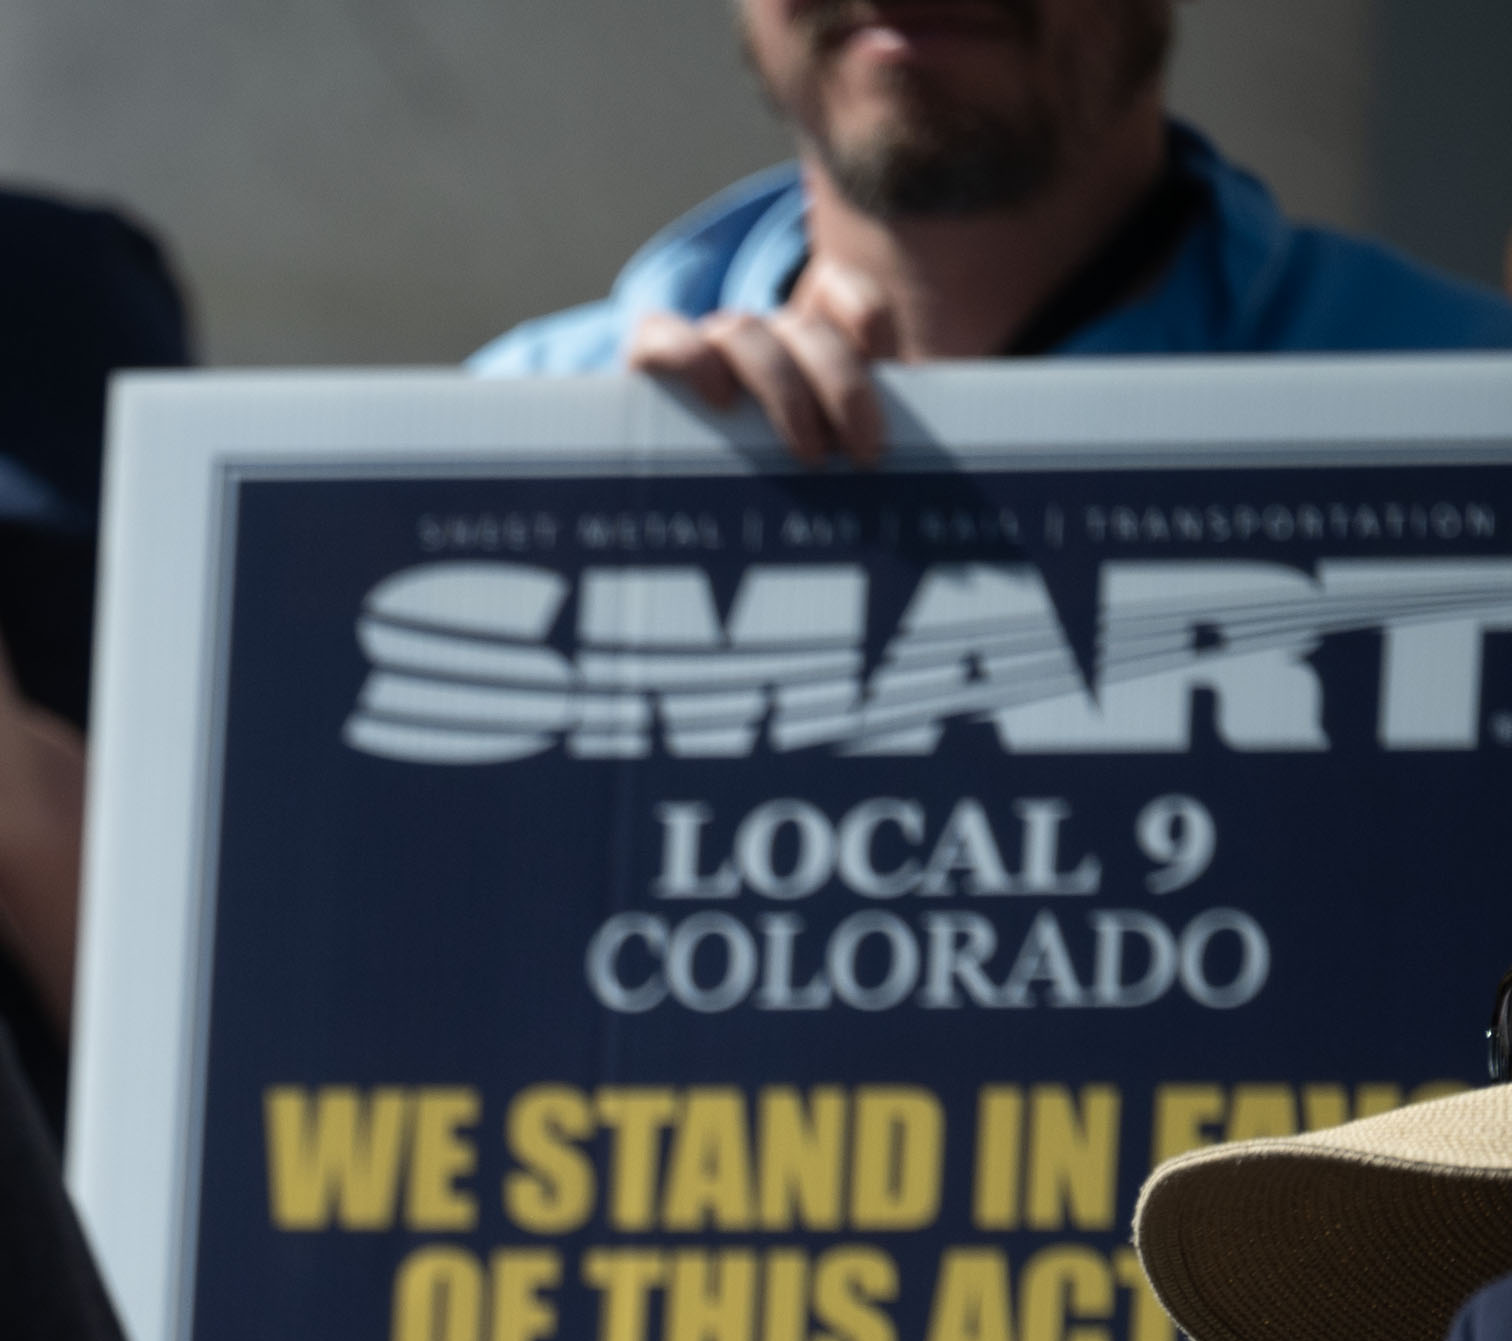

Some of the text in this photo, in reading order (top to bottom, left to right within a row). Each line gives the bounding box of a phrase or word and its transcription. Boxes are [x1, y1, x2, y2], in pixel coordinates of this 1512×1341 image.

[343, 557, 1512, 763] SMART
[656, 793, 1216, 900] LOCAL 9
[587, 910, 1271, 1012] COLORADO
[265, 1083, 480, 1230] WE
[505, 1083, 946, 1232] STAND
[972, 1081, 1120, 1230] IN
